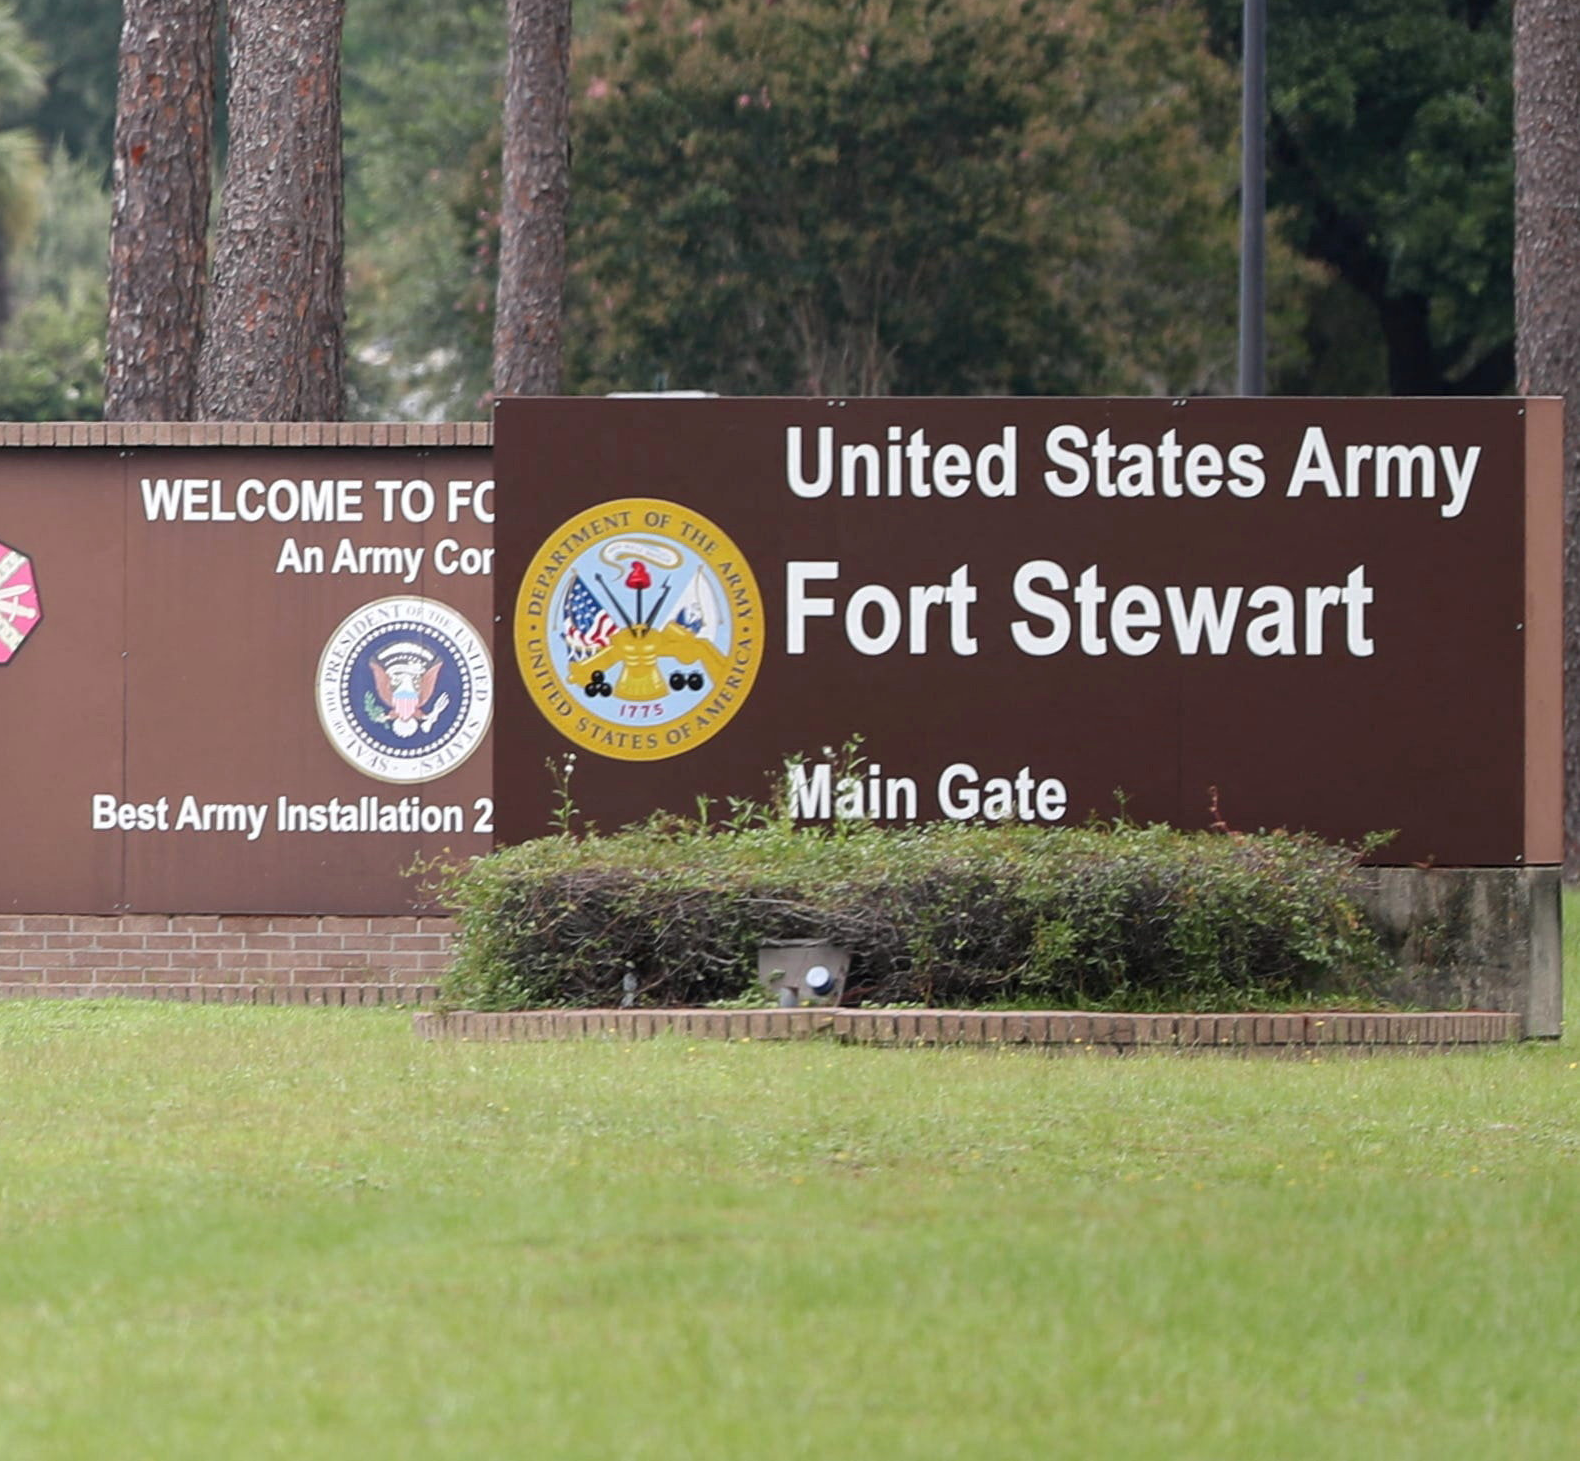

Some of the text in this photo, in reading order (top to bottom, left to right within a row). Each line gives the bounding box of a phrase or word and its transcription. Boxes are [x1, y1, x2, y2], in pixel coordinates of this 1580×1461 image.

[141, 479, 363, 522] WELCOME
[375, 480, 434, 522] TO
[786, 425, 1481, 519] United States Army
[275, 538, 324, 573] An
[331, 538, 423, 584] Army
[528, 511, 631, 616] DEPARTMENT
[644, 511, 671, 528] OF
[681, 521, 717, 556] THE
[719, 562, 755, 619] ARMY
[786, 560, 1374, 657] Fort Stewart
[325, 604, 404, 683] PRESIDENT
[454, 628, 489, 702] UNITED
[528, 639, 753, 749] UNITED STATES OF AMERICA
[619, 704, 664, 718] 1775
[347, 738, 390, 771] SEAL
[421, 719, 481, 774] STATES
[92, 794, 494, 839] Best Army Installation 2
[786, 764, 1067, 821] Main Gate
